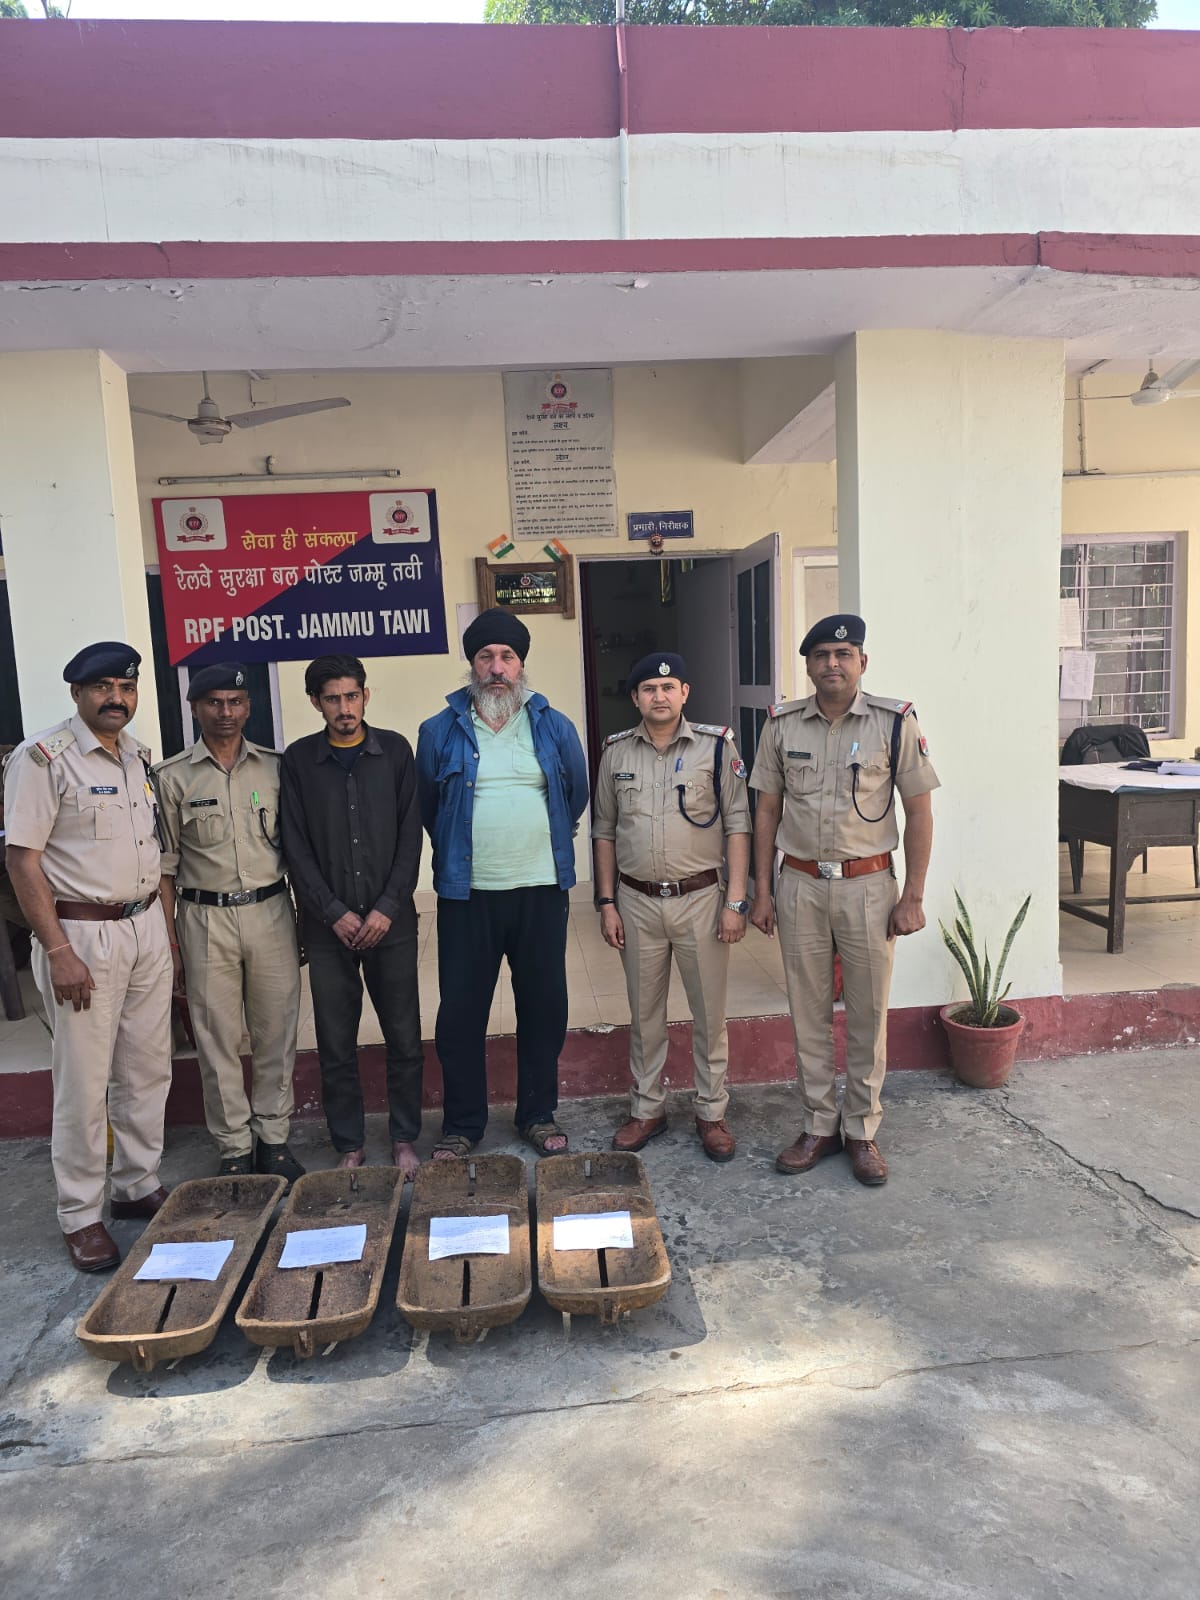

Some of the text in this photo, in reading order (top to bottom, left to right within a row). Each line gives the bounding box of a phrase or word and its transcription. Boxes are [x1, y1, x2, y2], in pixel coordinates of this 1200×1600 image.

[240, 530, 276, 551] सेवा
[281, 527, 298, 551] ही
[173, 553, 424, 597] रेलवे सुरक्षा बल पोस्ट जम्मू तवी
[184, 608, 431, 644] RPF POST. JAMMU TAWI
